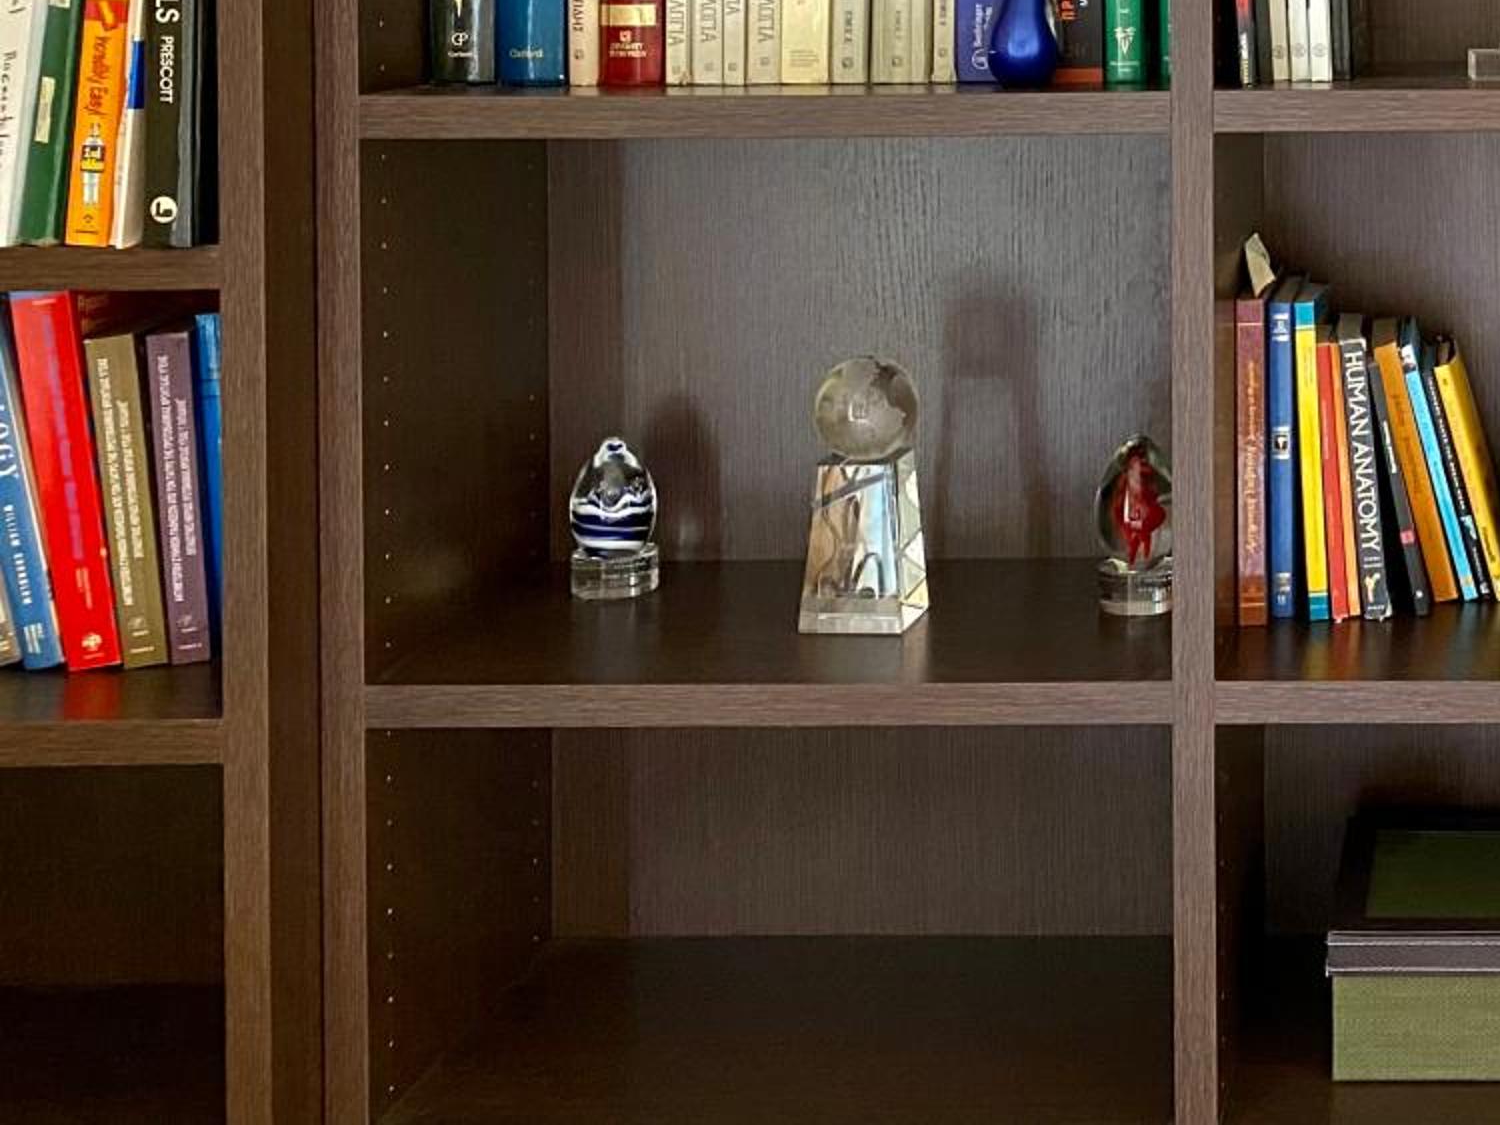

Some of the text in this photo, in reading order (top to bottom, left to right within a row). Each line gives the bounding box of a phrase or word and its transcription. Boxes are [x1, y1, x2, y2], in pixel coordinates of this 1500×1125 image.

[158, 34, 175, 105] PRESCOTT
[1343, 351, 1379, 551] HUMAN ANATOMY
[3, 504, 21, 547] WILLIAM
